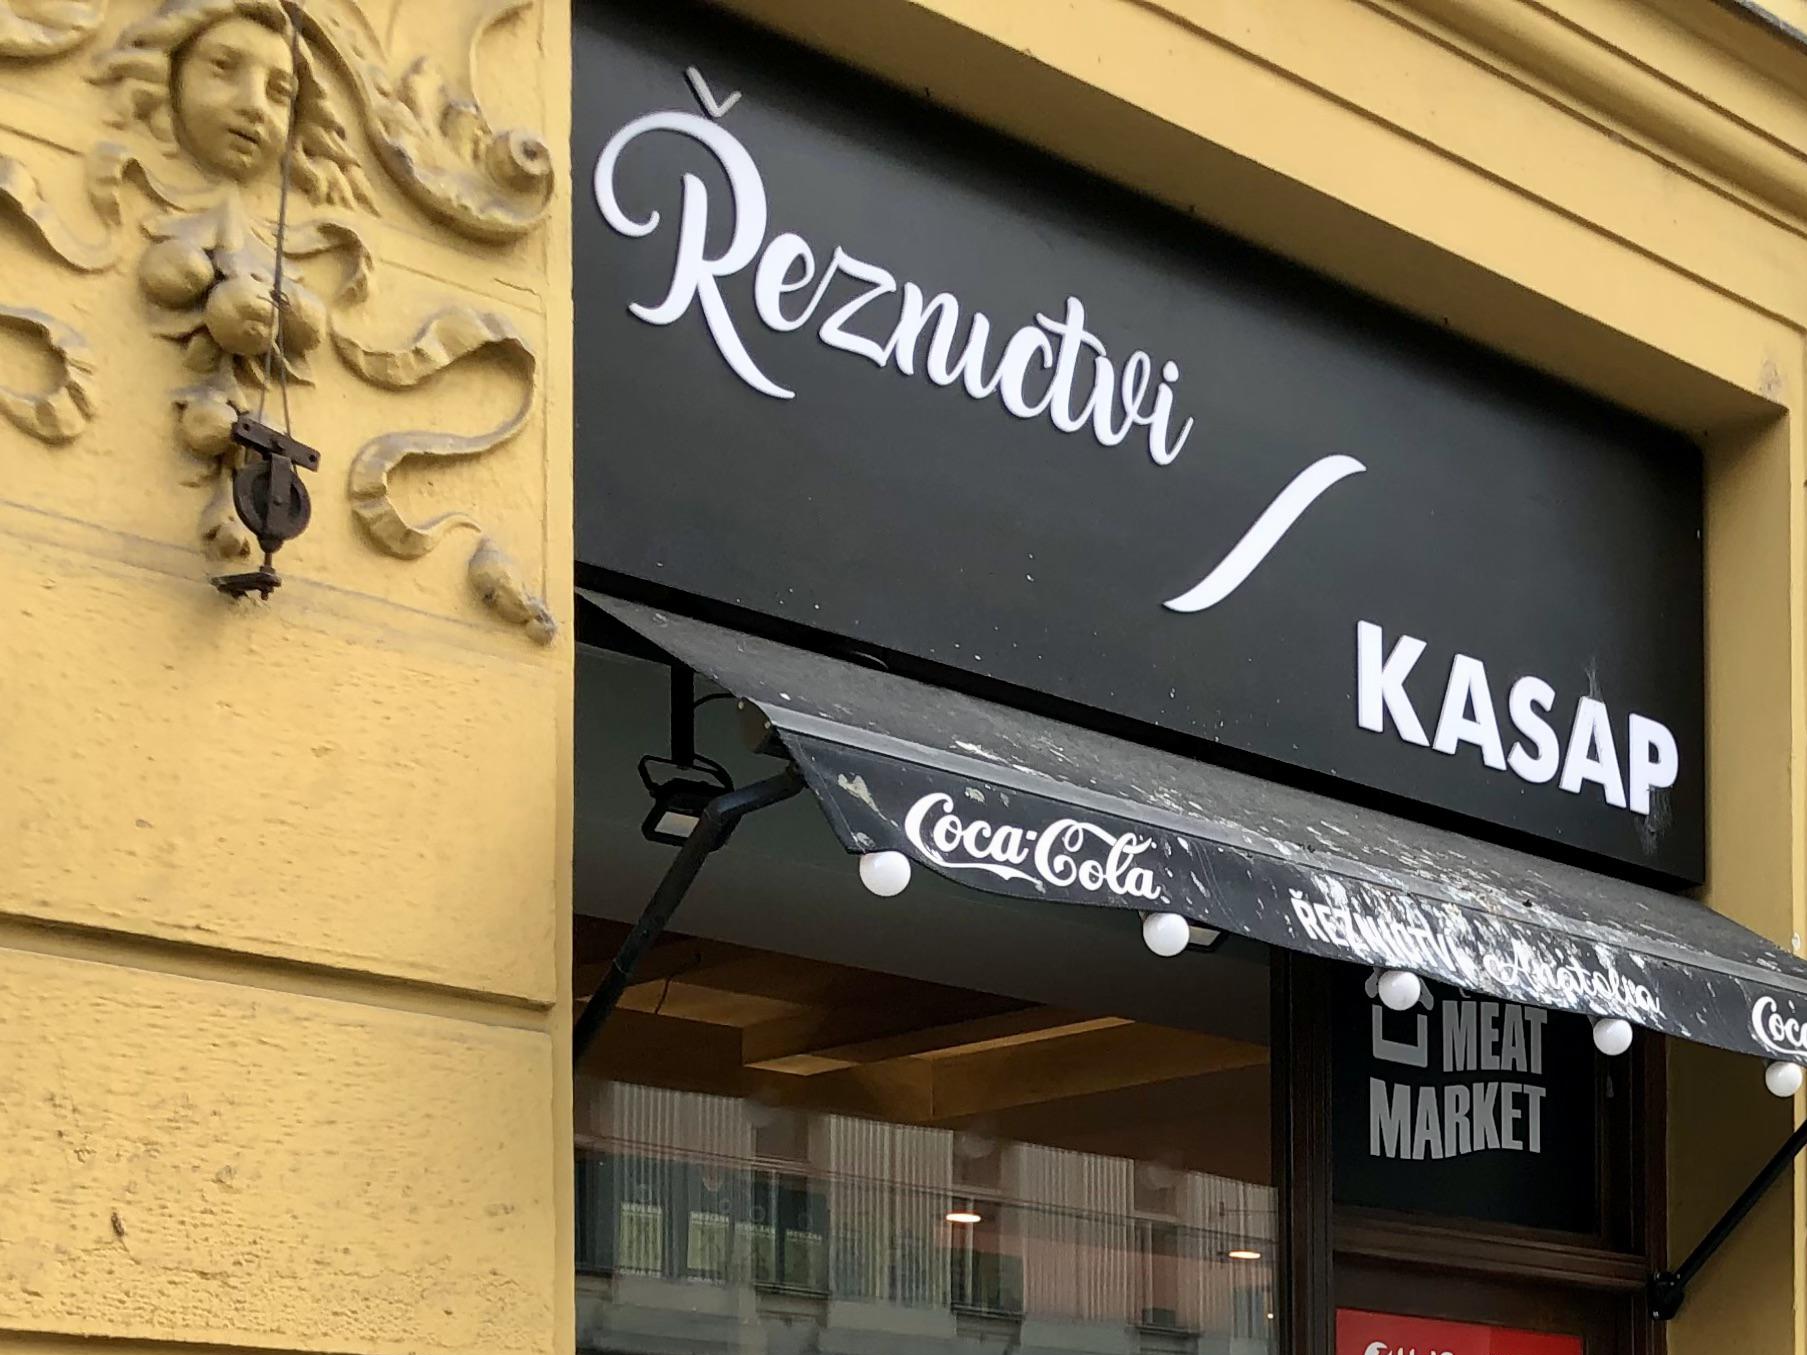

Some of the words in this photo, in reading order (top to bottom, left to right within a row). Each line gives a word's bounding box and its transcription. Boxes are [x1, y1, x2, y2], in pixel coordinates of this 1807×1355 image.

[1355, 619, 1681, 816] KASAP
[904, 792, 1163, 900] Coca-Cola
[1442, 1000, 1548, 1075] MEAT
[1369, 1076, 1547, 1160] MARKET
